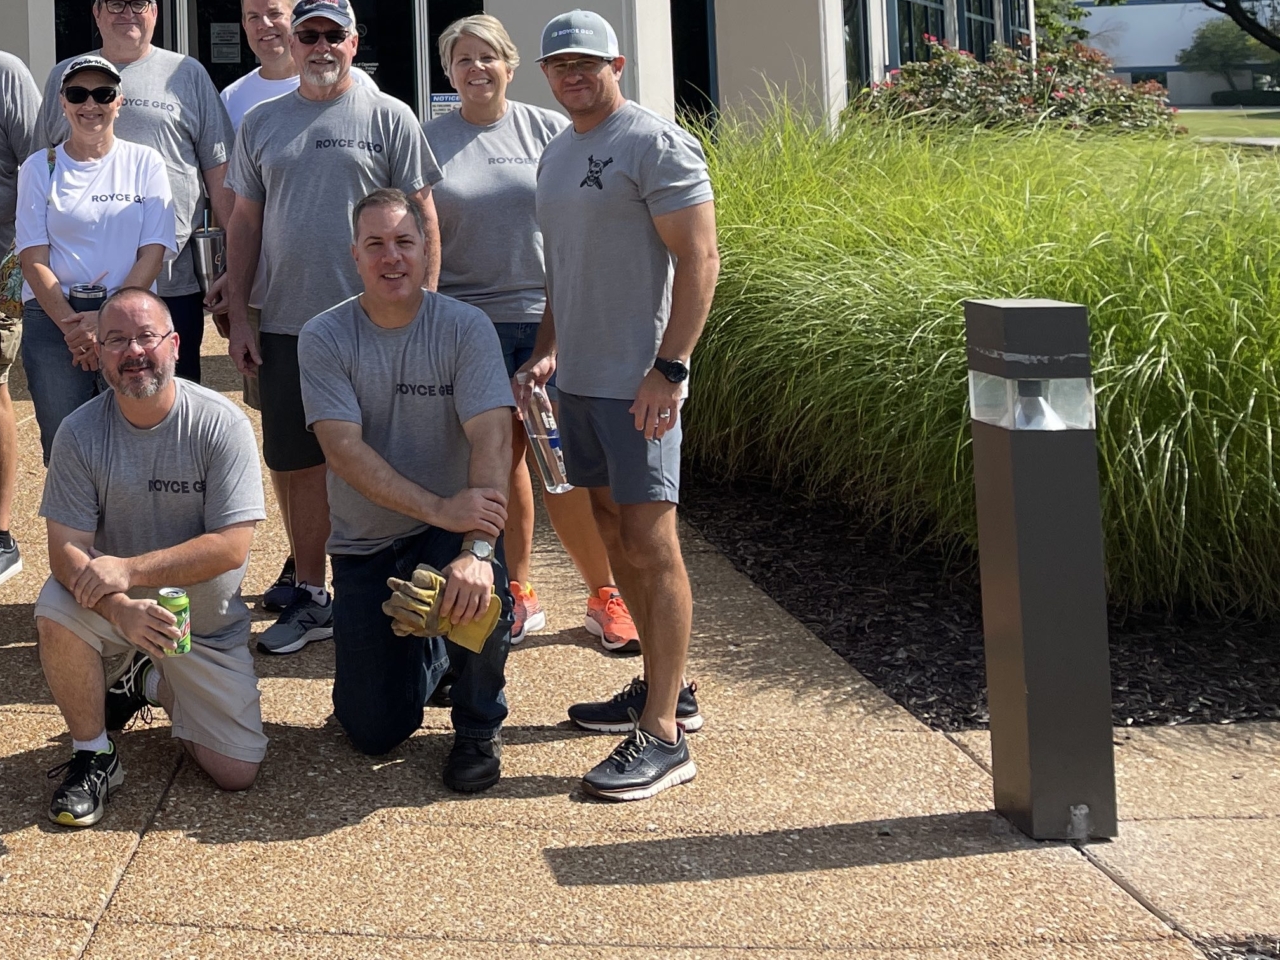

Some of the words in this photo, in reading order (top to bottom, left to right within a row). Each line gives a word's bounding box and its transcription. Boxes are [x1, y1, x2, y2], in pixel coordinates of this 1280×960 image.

[122, 98, 150, 107] OYCE
[151, 100, 175, 111] GEO
[315, 139, 355, 149] ROYCE
[357, 140, 383, 153] GEO
[91, 193, 131, 203] ROYCE
[438, 384, 454, 397] GE
[148, 479, 190, 494] ROYCE
[192, 480, 207, 493] GE
